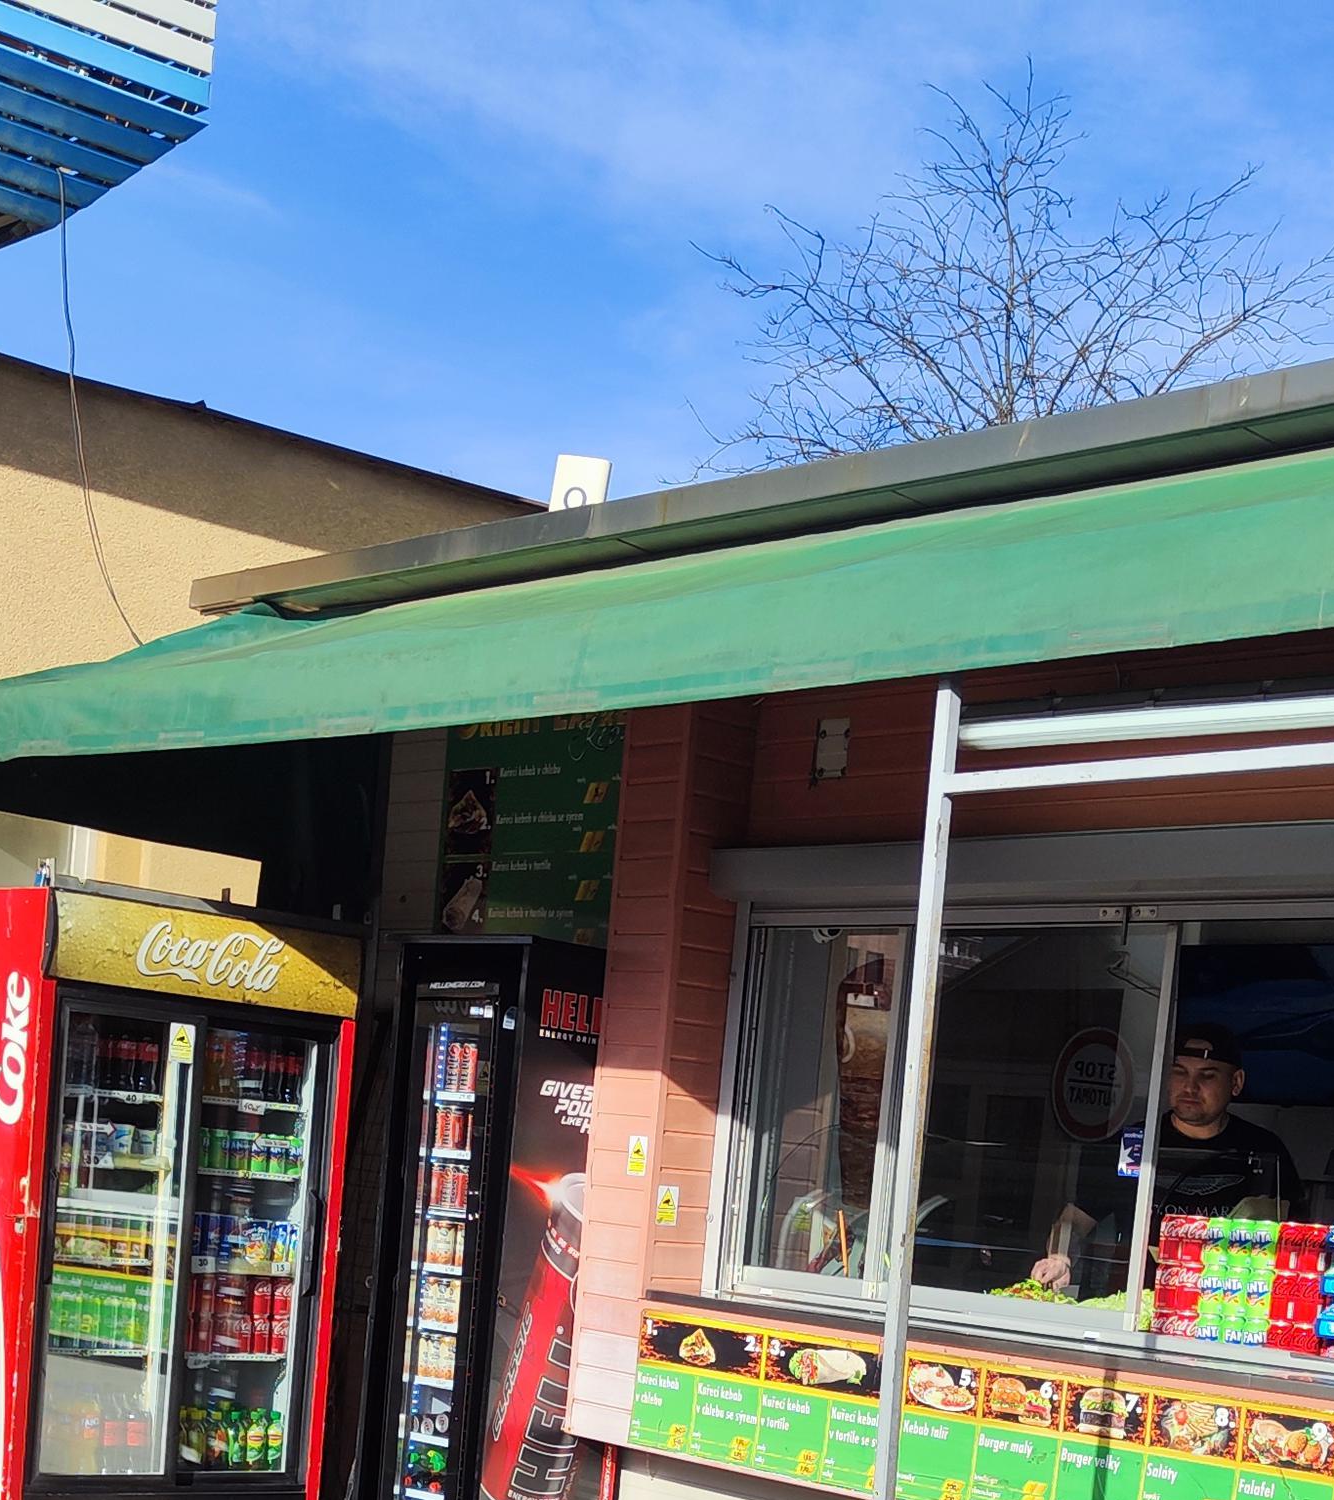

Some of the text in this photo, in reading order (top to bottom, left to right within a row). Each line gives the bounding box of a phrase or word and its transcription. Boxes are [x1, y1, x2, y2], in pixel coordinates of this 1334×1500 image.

[485, 771, 496, 785] 1.
[479, 816, 492, 831] 2.
[475, 864, 488, 878] 3.
[471, 909, 484, 923] 4.
[133, 919, 285, 993] Coca-Cola
[539, 988, 602, 1034] HELL
[539, 1028, 598, 1045] ENERGY DRIN
[540, 1079, 595, 1101] GIVES
[561, 1115, 583, 1127] LIKE
[276, 1264, 285, 1272] 15
[646, 1319, 658, 1336] 1.
[744, 1335, 760, 1353] 2.
[770, 1339, 786, 1357] 3.
[492, 1302, 533, 1442] CLASSIC
[637, 1371, 680, 1390] Kuřecí kebab
[958, 1368, 977, 1388] 5.
[697, 1382, 743, 1402] Kuřecí kebab
[1040, 1381, 1059, 1401] 6.
[701, 1403, 724, 1419] chlebu
[725, 1411, 735, 1419] se
[762, 1394, 810, 1415] Kuřecí kebab
[1124, 1393, 1143, 1414] 7.
[831, 1406, 857, 1424] Kuřecí
[1215, 1407, 1236, 1428] 8.
[903, 1419, 929, 1437] Kebab
[1312, 1422, 1334, 1444] 9.
[829, 1430, 834, 1439] v
[860, 1437, 870, 1446] se
[978, 1433, 1033, 1459] Burger malý
[1061, 1447, 1121, 1475] Burger velký
[1146, 1462, 1178, 1485] Saláty
[1238, 1478, 1276, 1500] Falafel
